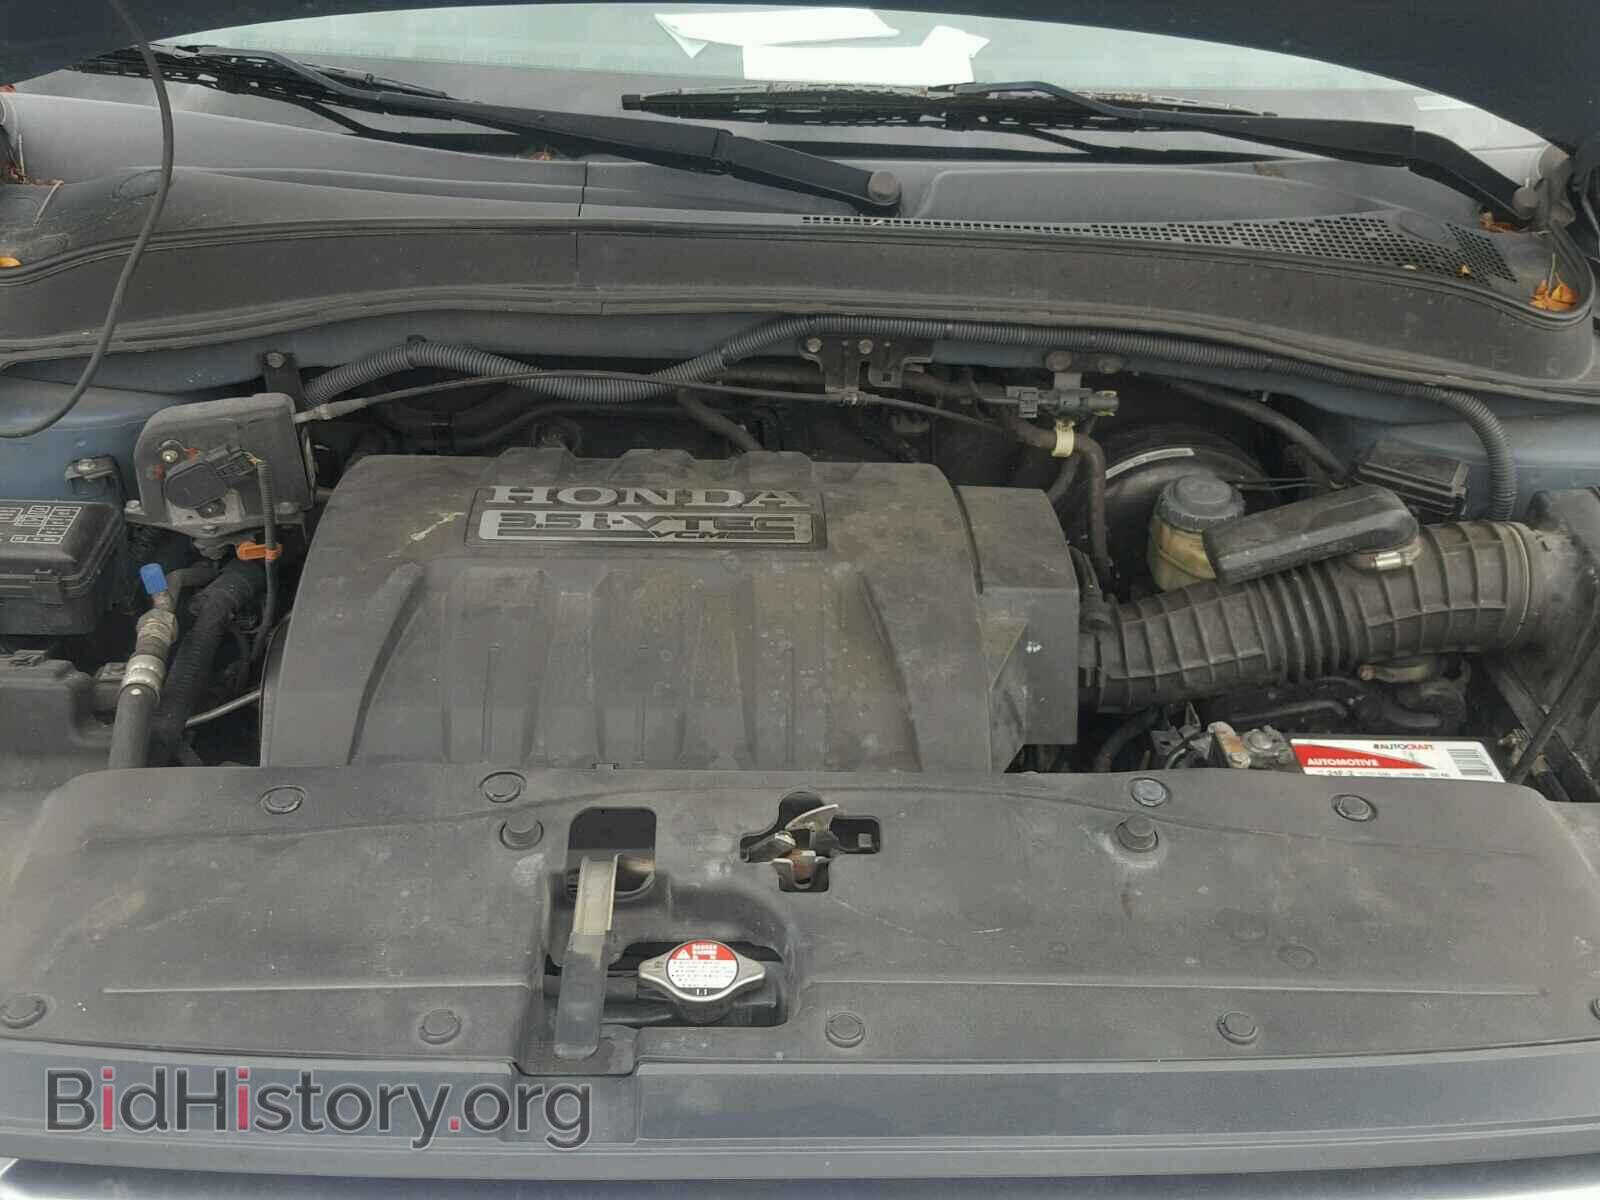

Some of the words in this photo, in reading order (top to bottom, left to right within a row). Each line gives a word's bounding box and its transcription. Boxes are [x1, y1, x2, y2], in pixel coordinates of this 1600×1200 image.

[486, 486, 811, 505] HONDA
[498, 512, 582, 529] 3.5
[652, 530, 728, 539] VCM
[1307, 758, 1378, 767] AUTOMOTIVE
